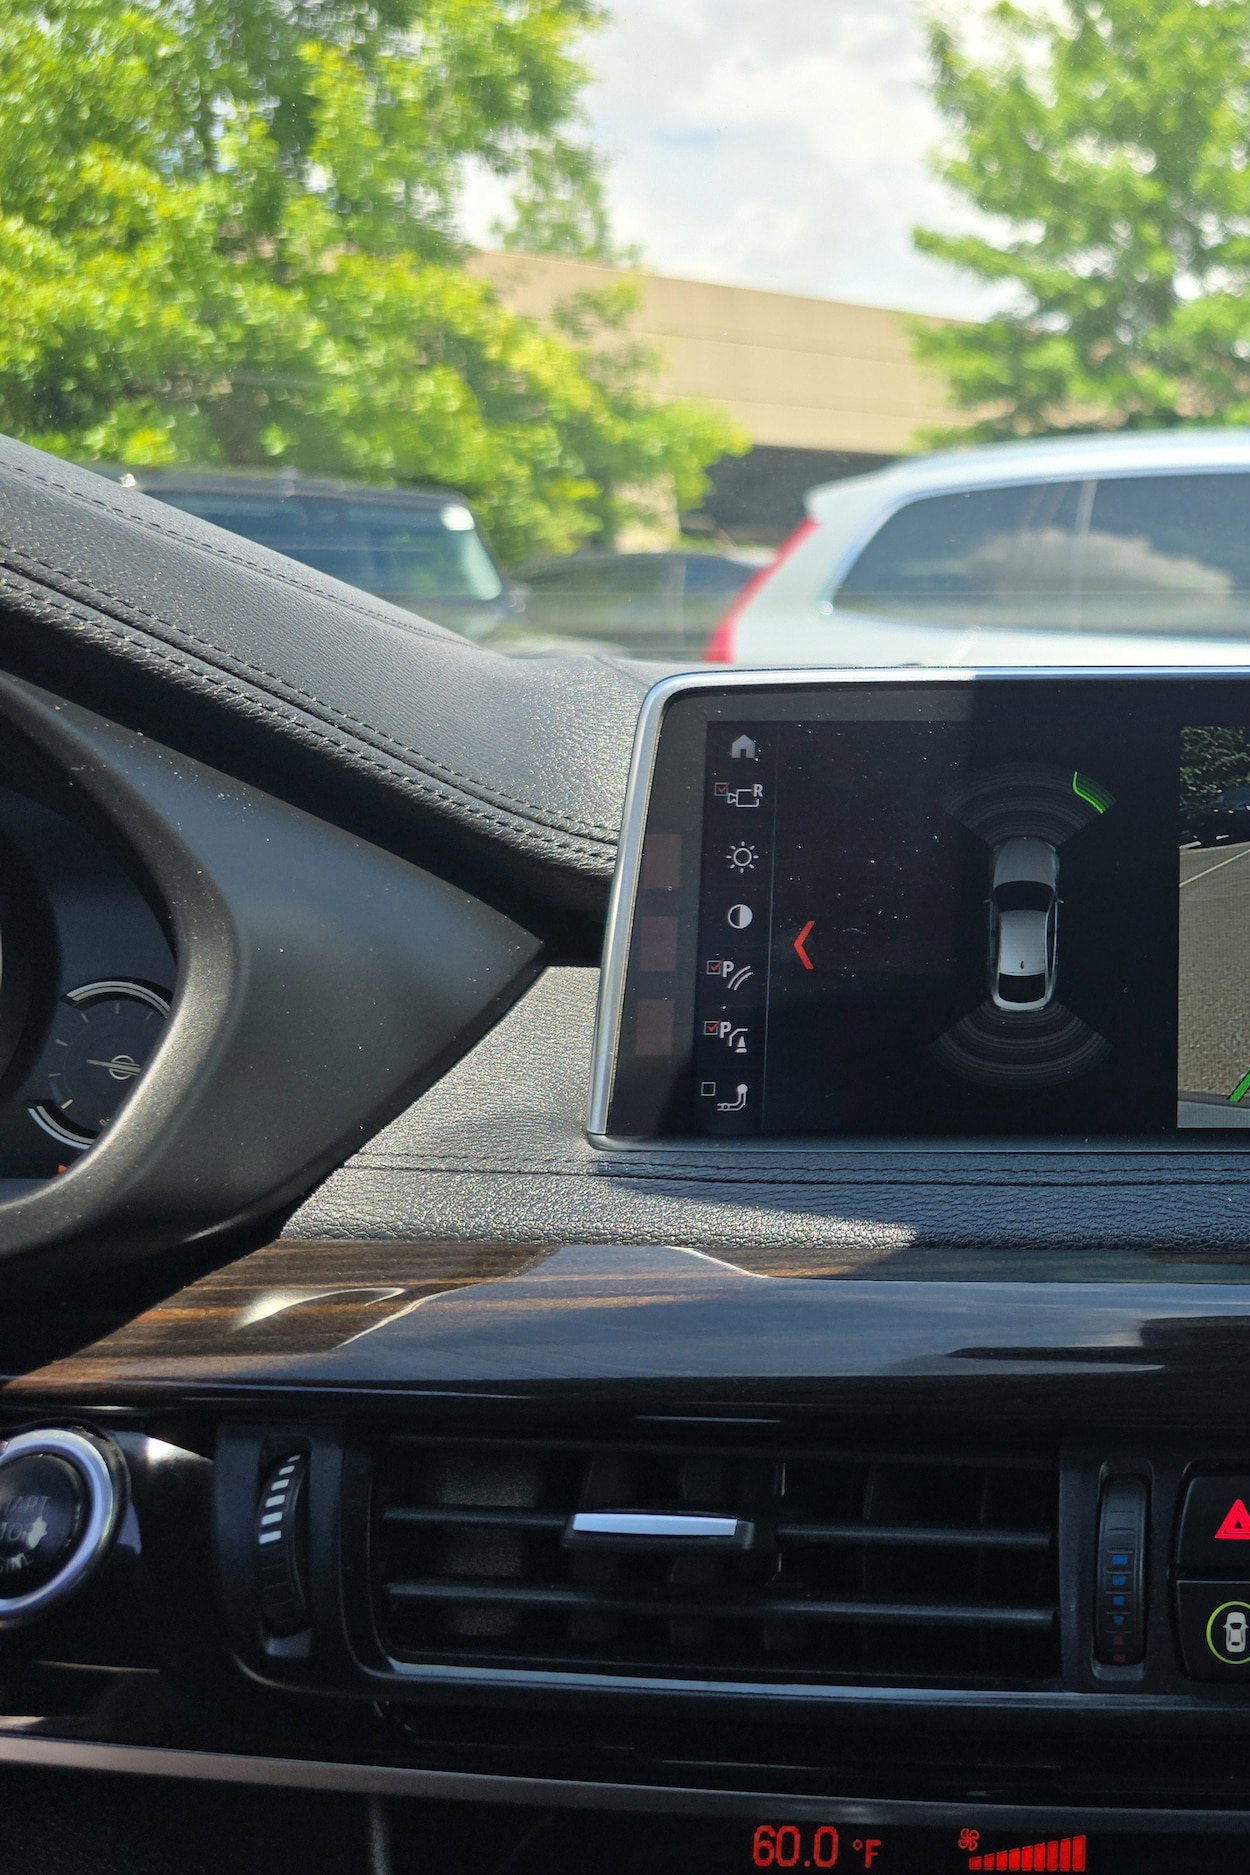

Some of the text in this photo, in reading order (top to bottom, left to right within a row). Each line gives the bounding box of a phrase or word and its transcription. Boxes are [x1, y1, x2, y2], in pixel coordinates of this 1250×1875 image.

[722, 961, 734, 977] P
[719, 1021, 731, 1038] P
[753, 1825, 838, 1867] 60.0
